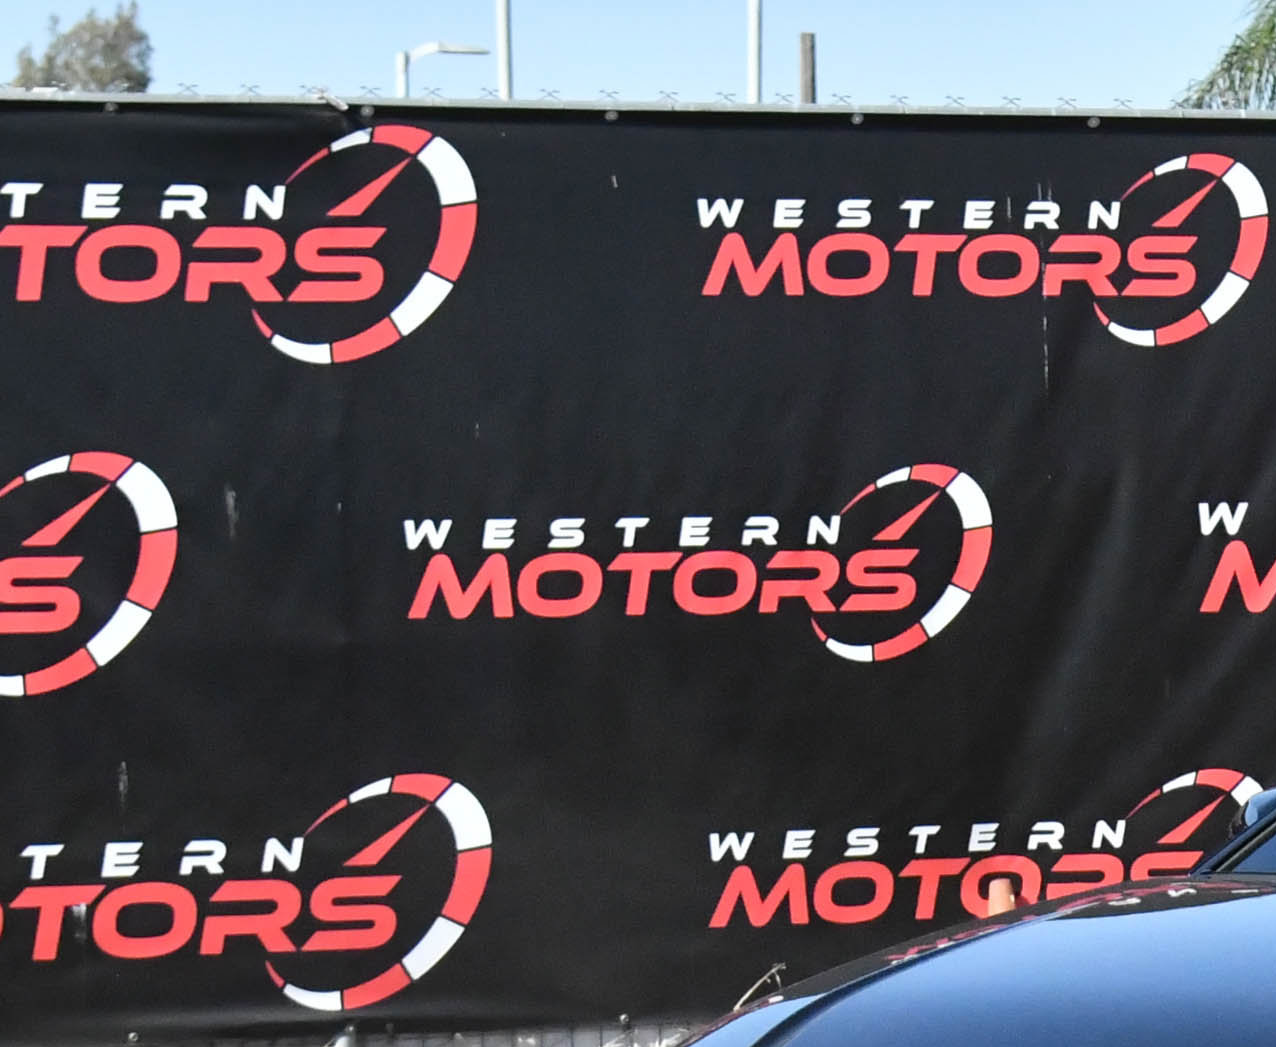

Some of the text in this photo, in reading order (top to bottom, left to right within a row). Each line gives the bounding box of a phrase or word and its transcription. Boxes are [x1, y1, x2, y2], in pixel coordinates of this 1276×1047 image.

[0, 182, 286, 221] TERN
[697, 198, 1121, 230] WESTERN
[0, 224, 387, 303] TORS
[701, 232, 1198, 298] MOTORS
[403, 515, 841, 550] WESTERN
[407, 548, 920, 620] MOTORS
[21, 837, 305, 880] TERN
[709, 819, 1126, 862] WESTERN
[0, 874, 402, 961] TORS
